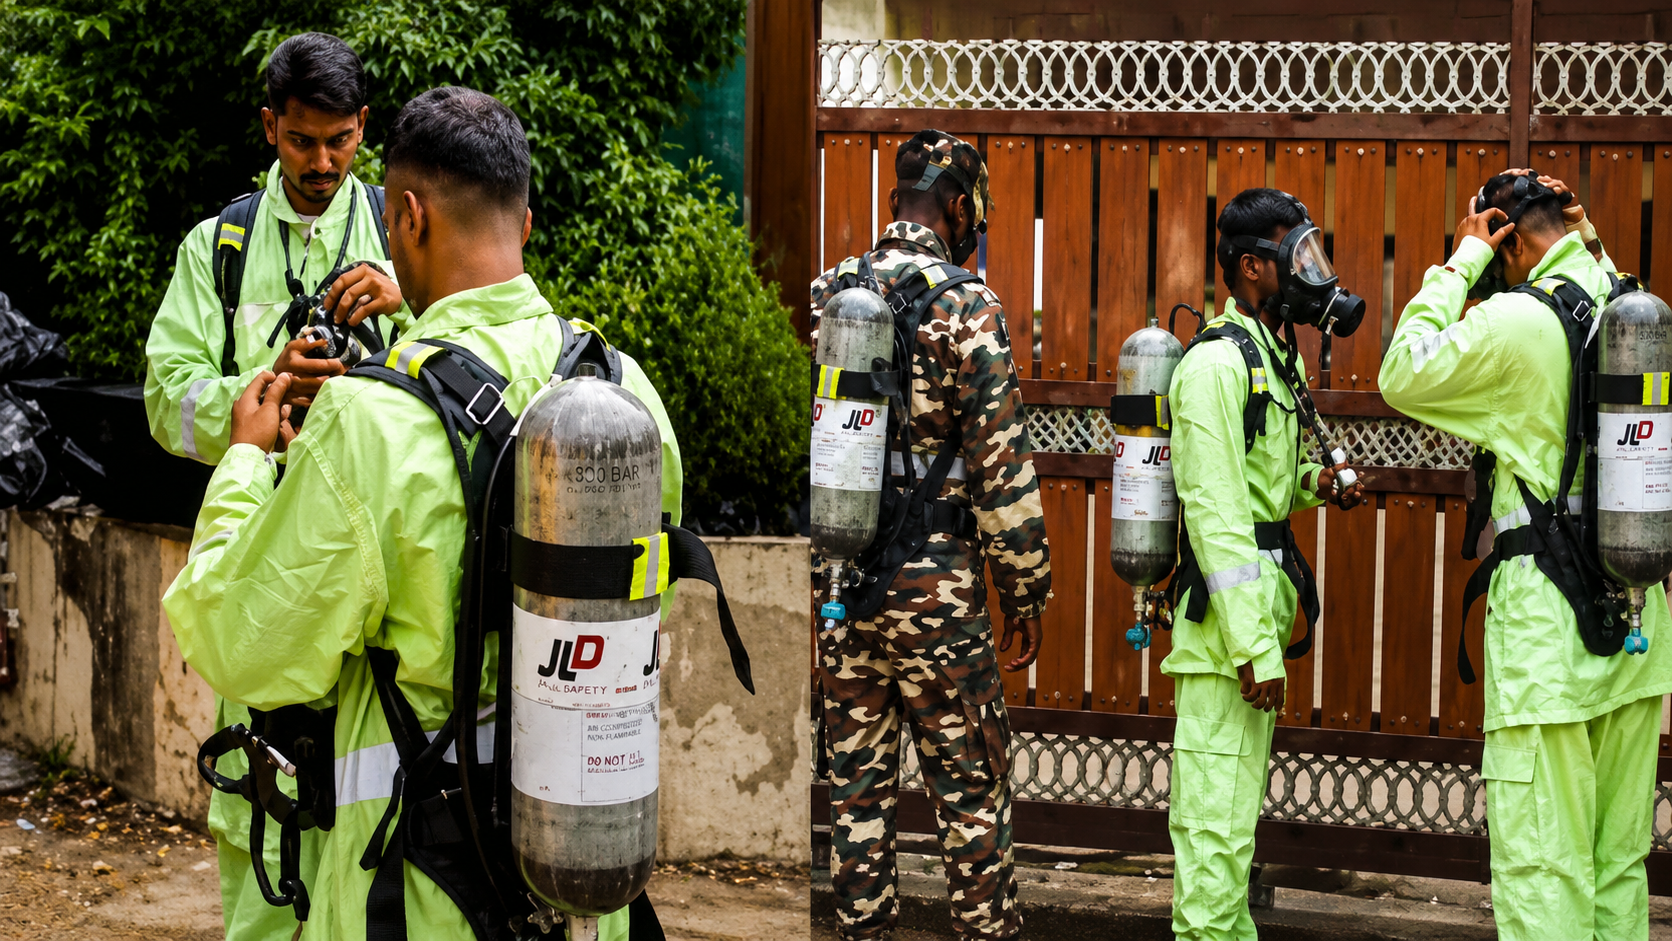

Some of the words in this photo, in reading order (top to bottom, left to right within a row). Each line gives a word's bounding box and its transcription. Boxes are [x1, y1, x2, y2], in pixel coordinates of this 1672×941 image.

[842, 408, 875, 431] JLD
[1617, 420, 1654, 446] JLD
[611, 465, 640, 483] BAR
[537, 634, 605, 682] JLD
[587, 756, 602, 766] DO
[604, 754, 626, 766] NOT
